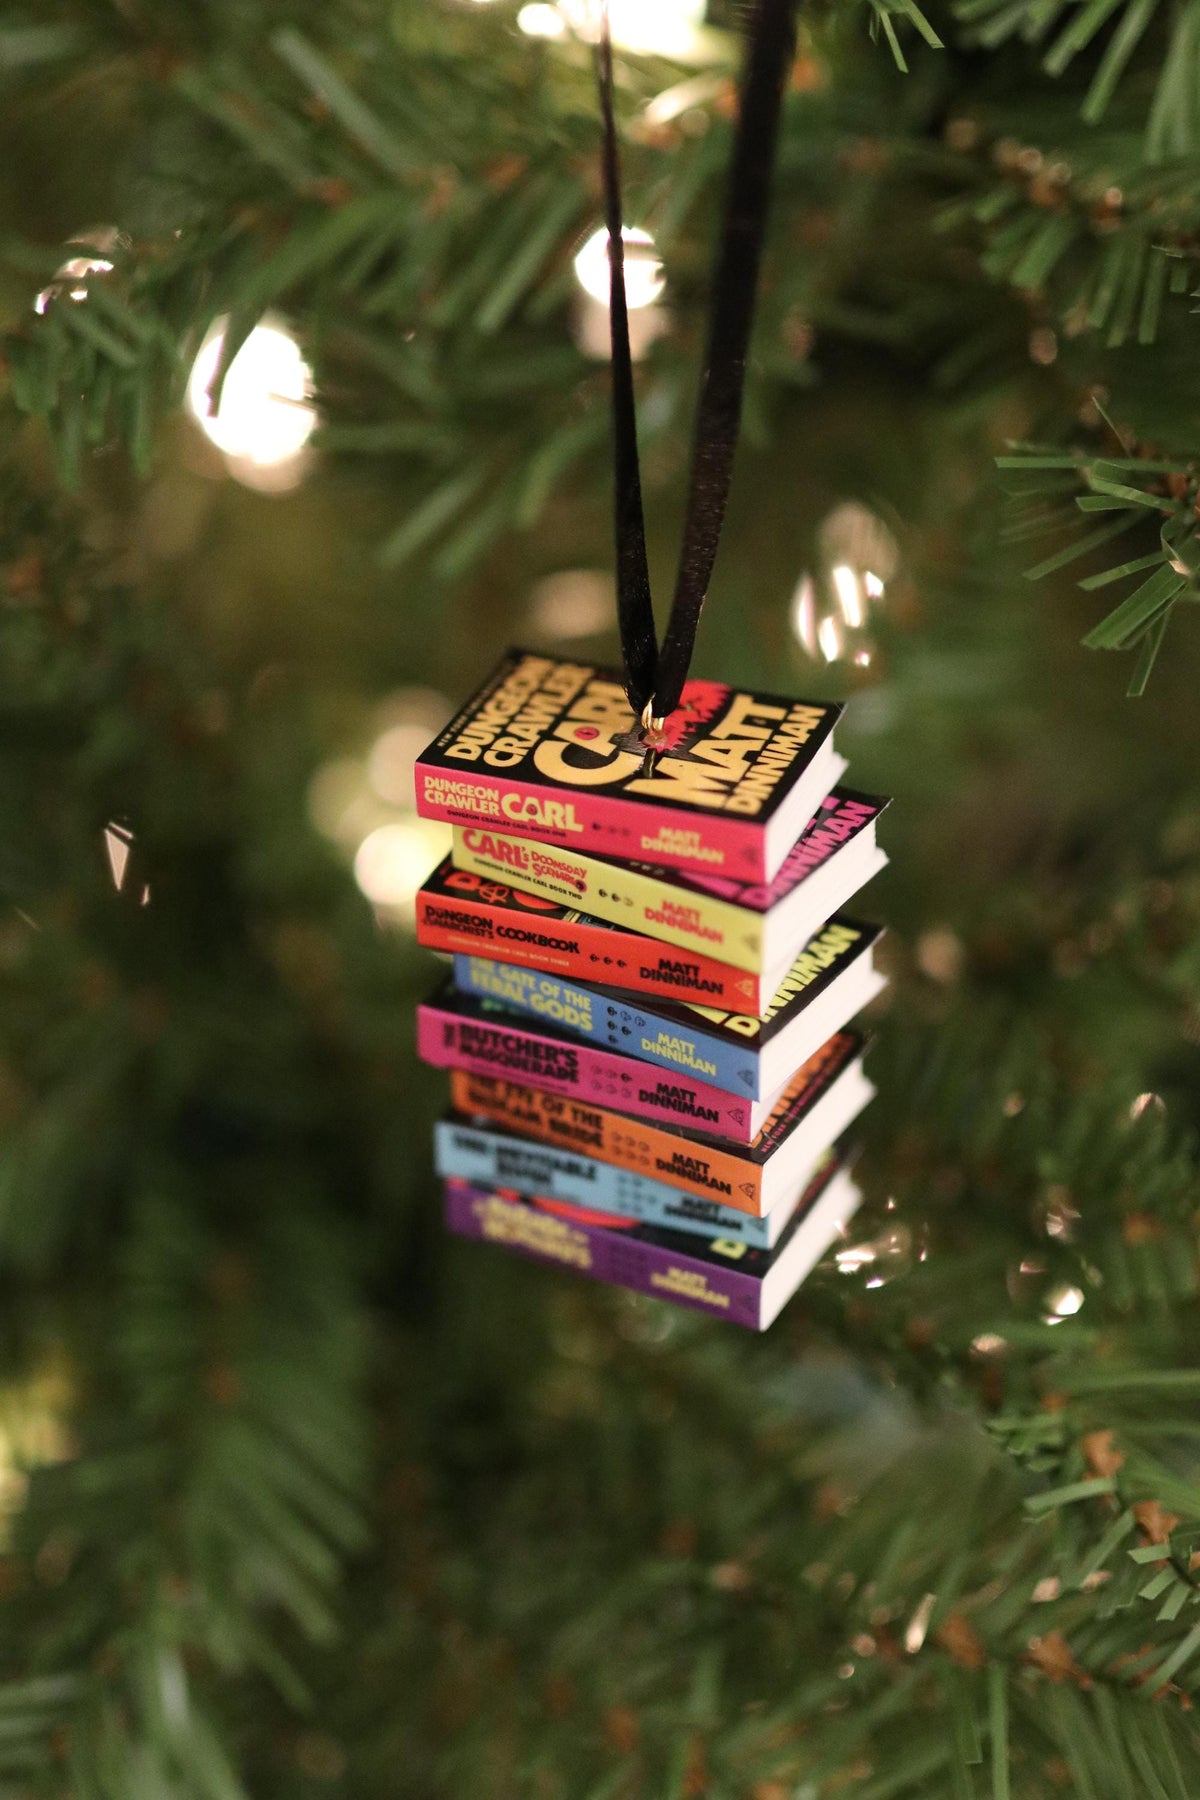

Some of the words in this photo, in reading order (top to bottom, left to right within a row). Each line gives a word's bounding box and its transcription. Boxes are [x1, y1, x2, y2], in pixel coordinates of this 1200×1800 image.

[443, 656, 555, 762] DUNGEON
[483, 663, 597, 768] CRAWLER
[622, 693, 788, 810] MATT
[724, 703, 828, 816] DINNIMAN
[424, 776, 499, 802] DUNGEON
[424, 789, 500, 816] CRAWLER
[501, 793, 584, 832] CARL
[641, 836, 725, 865] DINNIMAN
[658, 827, 702, 849] MATT
[531, 850, 588, 879] DOOMSDAY
[645, 906, 724, 944] DINNIMAN
[662, 900, 701, 924] MATT
[496, 926, 580, 955] COOKBOOK
[640, 966, 724, 996] DINNIMAN
[658, 958, 699, 980] MATT
[540, 980, 560, 998] OF
[564, 988, 592, 1012] THE
[530, 993, 593, 1032] GODS
[460, 1022, 579, 1071] BUTCHER'S
[641, 1037, 717, 1077] DINNIMAN
[657, 1032, 696, 1055] MATT
[638, 1089, 720, 1125] DINNIMAN
[656, 1083, 697, 1102] MATT
[655, 1158, 732, 1196] DINNIMAN
[672, 1152, 711, 1175] MATT
